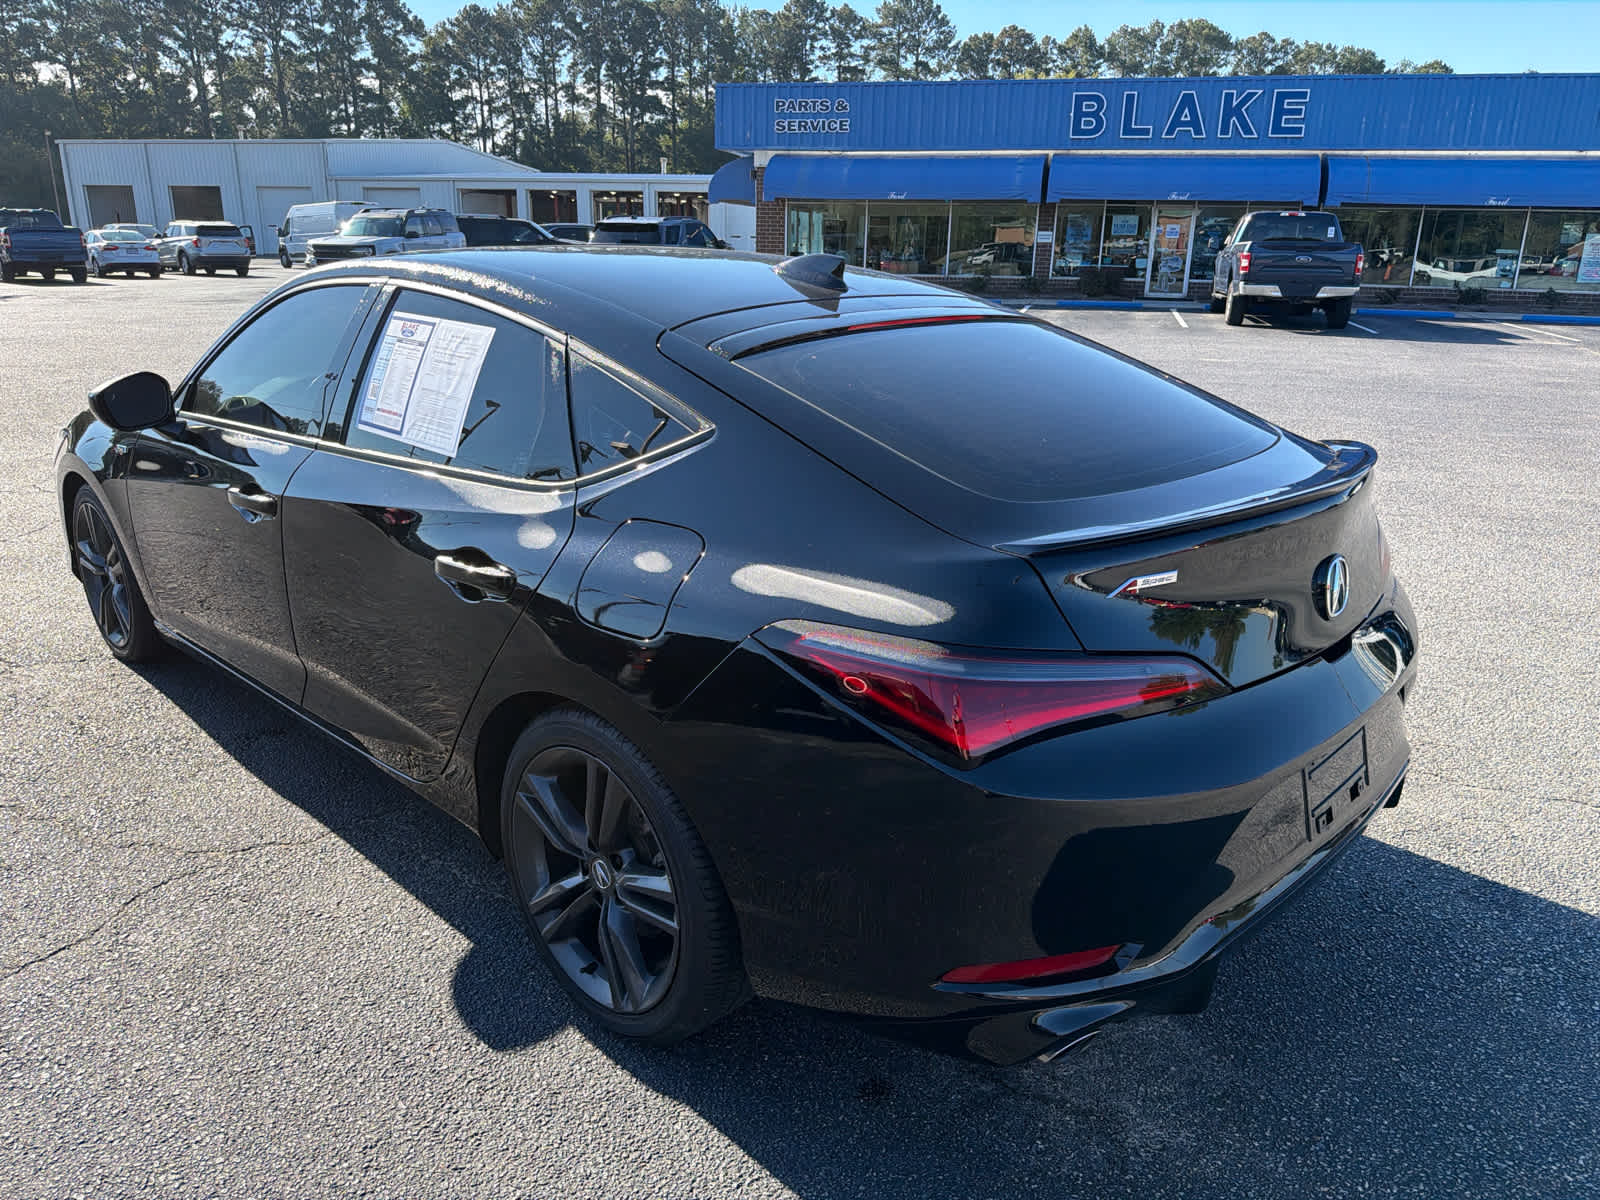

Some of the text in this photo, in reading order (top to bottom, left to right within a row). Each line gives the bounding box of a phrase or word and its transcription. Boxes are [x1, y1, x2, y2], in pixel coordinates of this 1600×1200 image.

[774, 98, 850, 113] PARTS &
[1070, 89, 1310, 138] BLAKE
[774, 118, 850, 133] SERVICE
